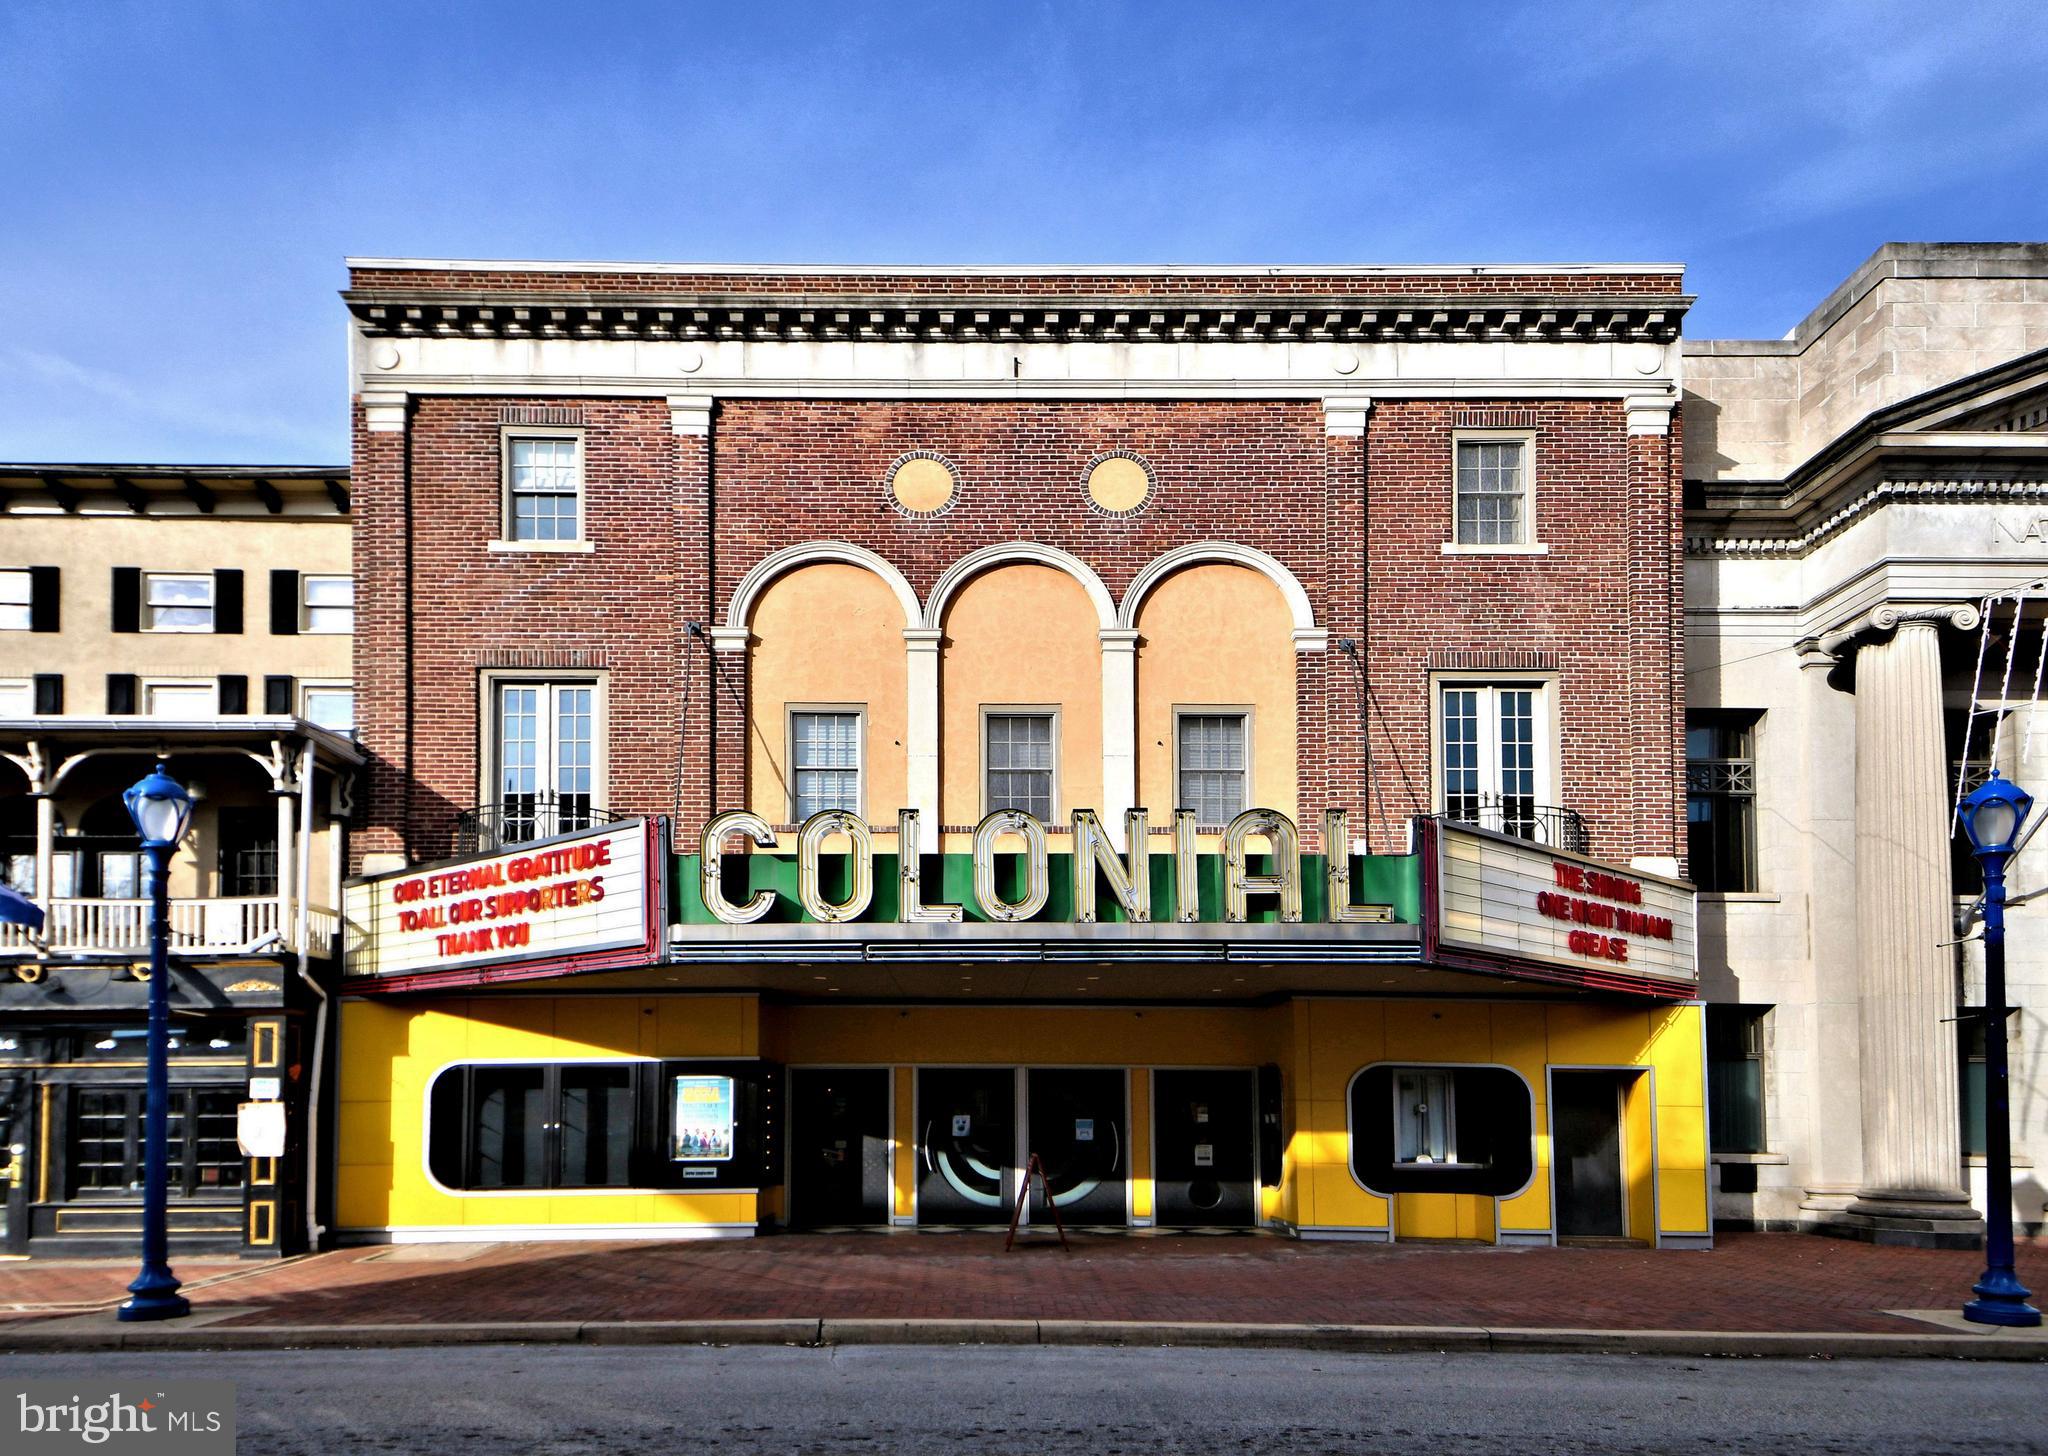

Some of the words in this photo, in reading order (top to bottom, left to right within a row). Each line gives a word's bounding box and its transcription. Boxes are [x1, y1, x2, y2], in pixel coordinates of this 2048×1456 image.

[393, 878, 425, 904] OUR
[428, 863, 506, 898] ETERNAL
[507, 839, 611, 883] GRATITUDE
[700, 808, 1394, 924] COLONIAL
[1553, 862, 1584, 892] THE
[1585, 871, 1641, 904] SHINING
[449, 898, 482, 925] OUR
[485, 876, 605, 919] SUPPORTERS
[1537, 891, 1570, 920] ONE
[1572, 898, 1615, 929] NIGHT
[436, 926, 493, 956] THANK
[495, 922, 530, 948] YOU
[1568, 930, 1628, 961] GREASE
